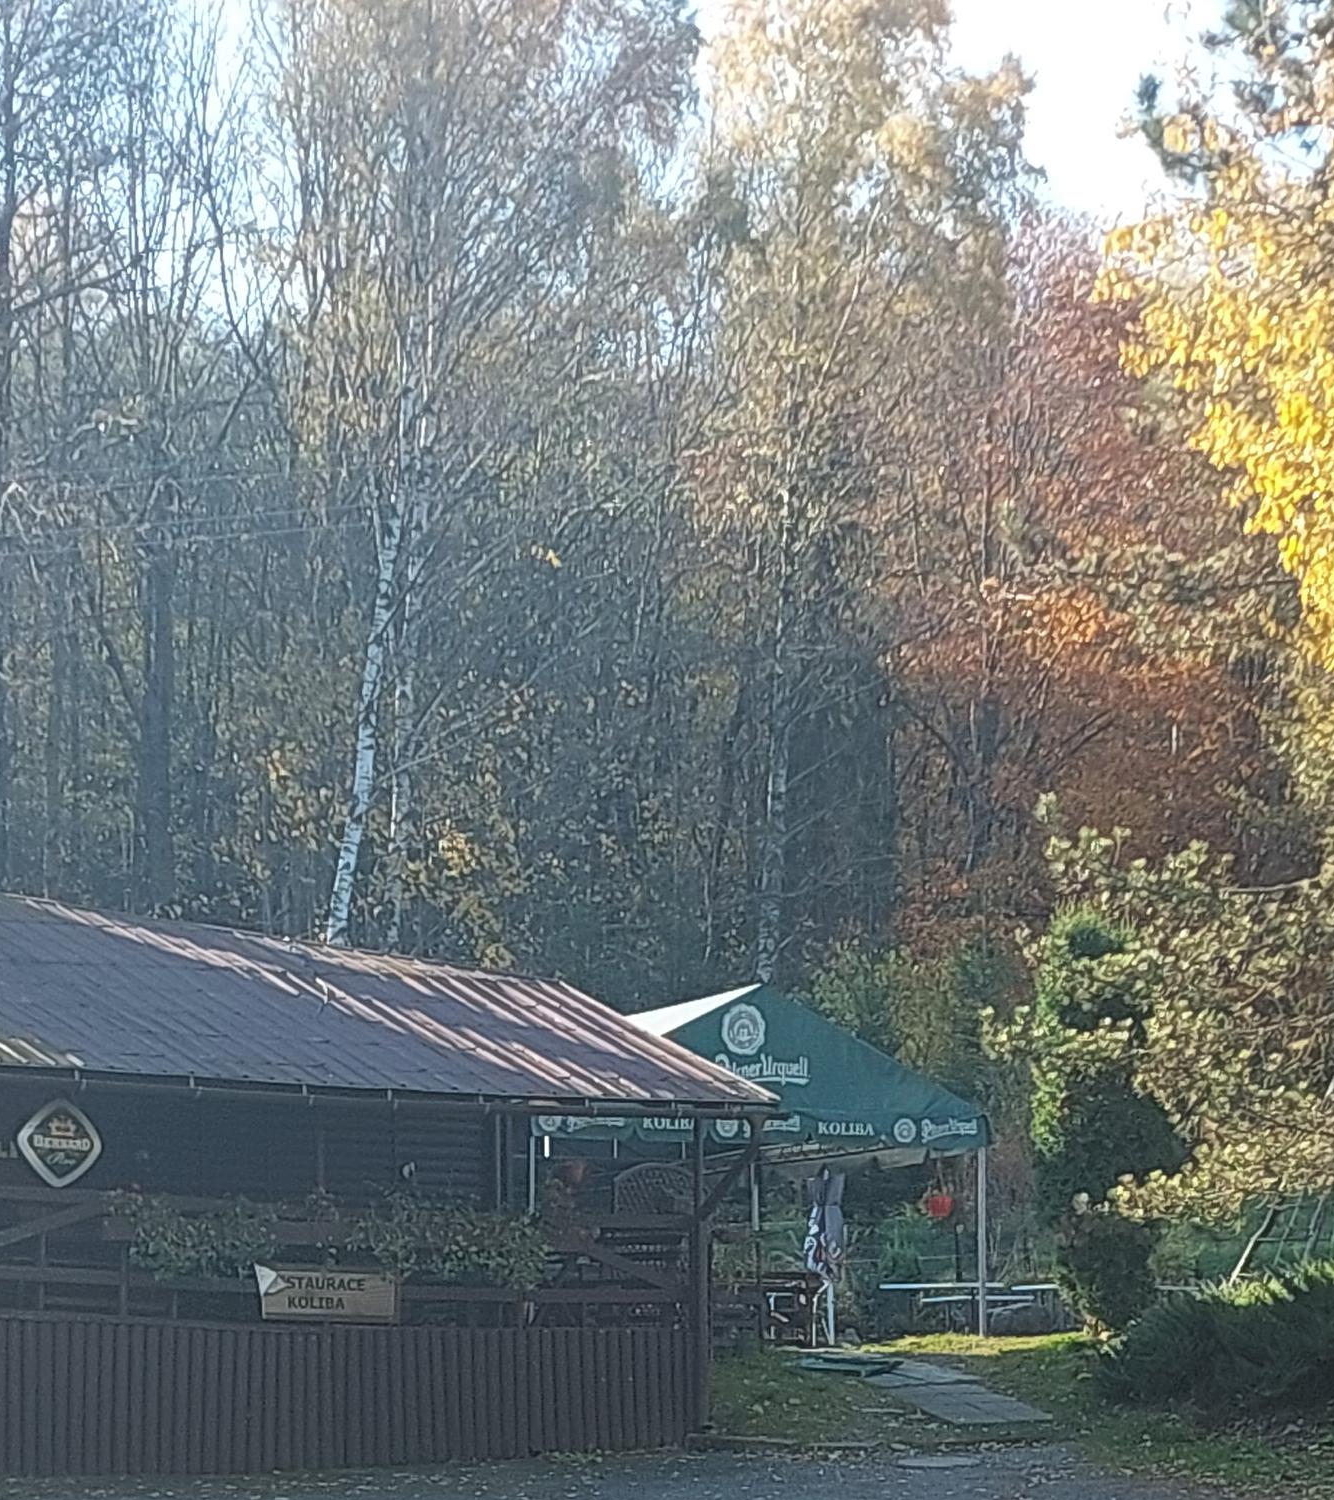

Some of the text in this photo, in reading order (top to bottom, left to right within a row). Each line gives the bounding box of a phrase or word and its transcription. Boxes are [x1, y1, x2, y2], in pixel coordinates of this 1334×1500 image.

[760, 1053, 809, 1085] Urquell
[818, 1120, 874, 1137] KOLIBA
[287, 1295, 345, 1310] KOLIBA
